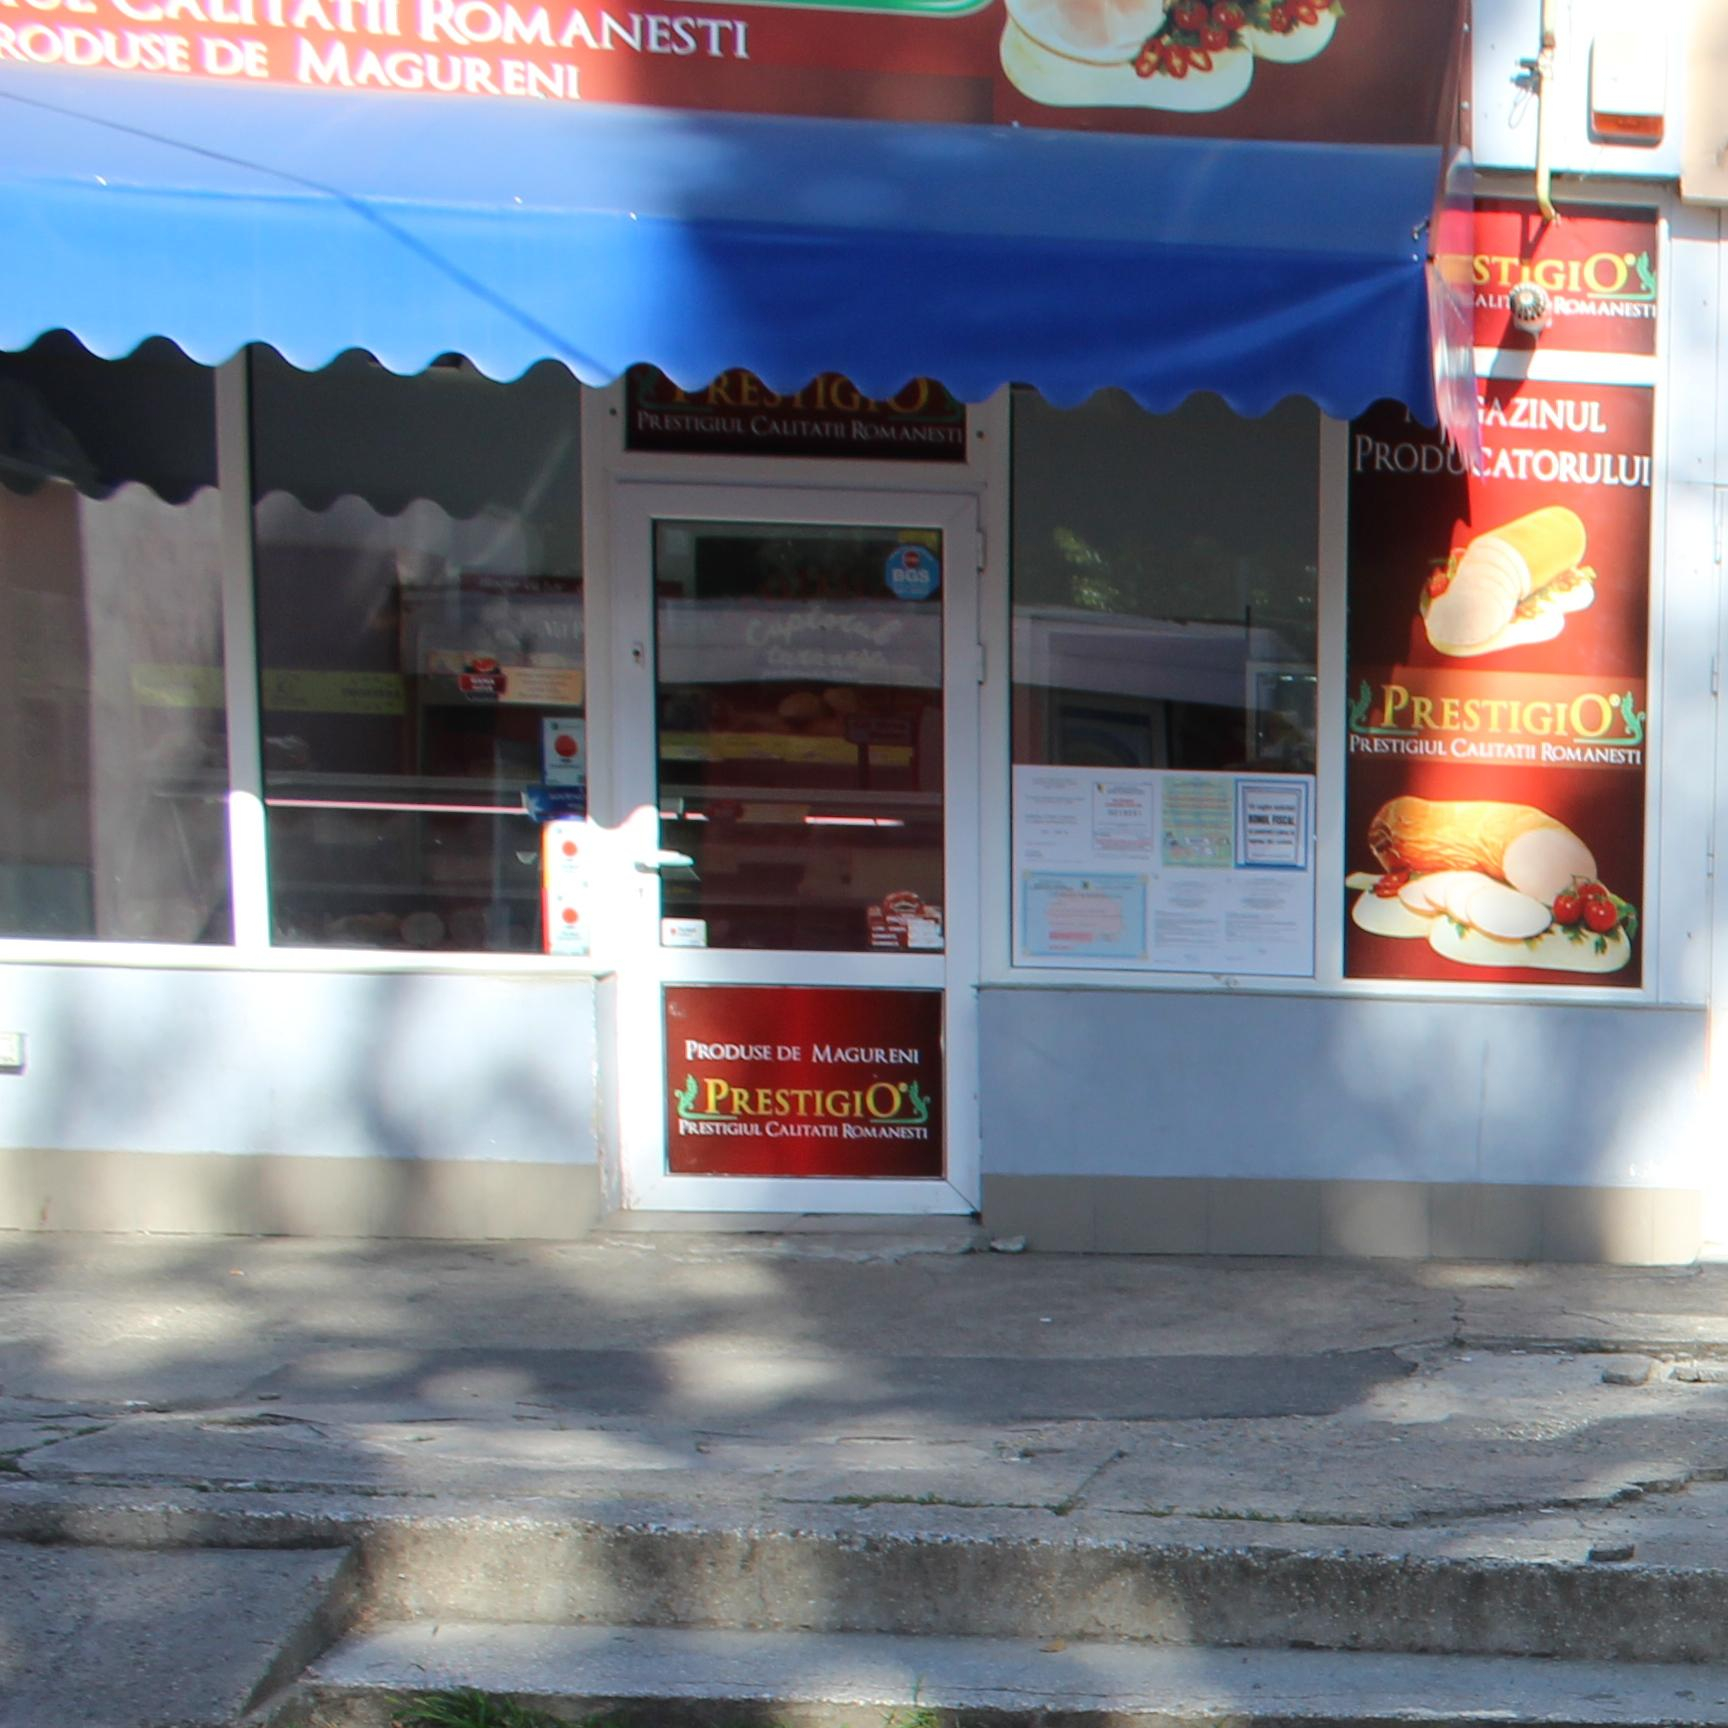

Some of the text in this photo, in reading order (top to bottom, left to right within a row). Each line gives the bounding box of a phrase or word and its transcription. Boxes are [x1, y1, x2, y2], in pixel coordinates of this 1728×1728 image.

[416, 0, 750, 60] ROMANESTI
[0, 21, 581, 100] RODUSE DE MAGURENI
[637, 411, 964, 444] PRESTIGIUL CALITATII ROMANESTI
[1381, 684, 1613, 738] PRESTIGIO
[1350, 735, 1642, 766] PRESTIGIUL CALITATII ROMANESTI
[684, 1039, 919, 1065] PRODUSE DE MAGURENI
[703, 1077, 902, 1119] PRESTIGIO
[678, 1118, 928, 1141] PRESTIGIUL CALITATII ROMANESTI
